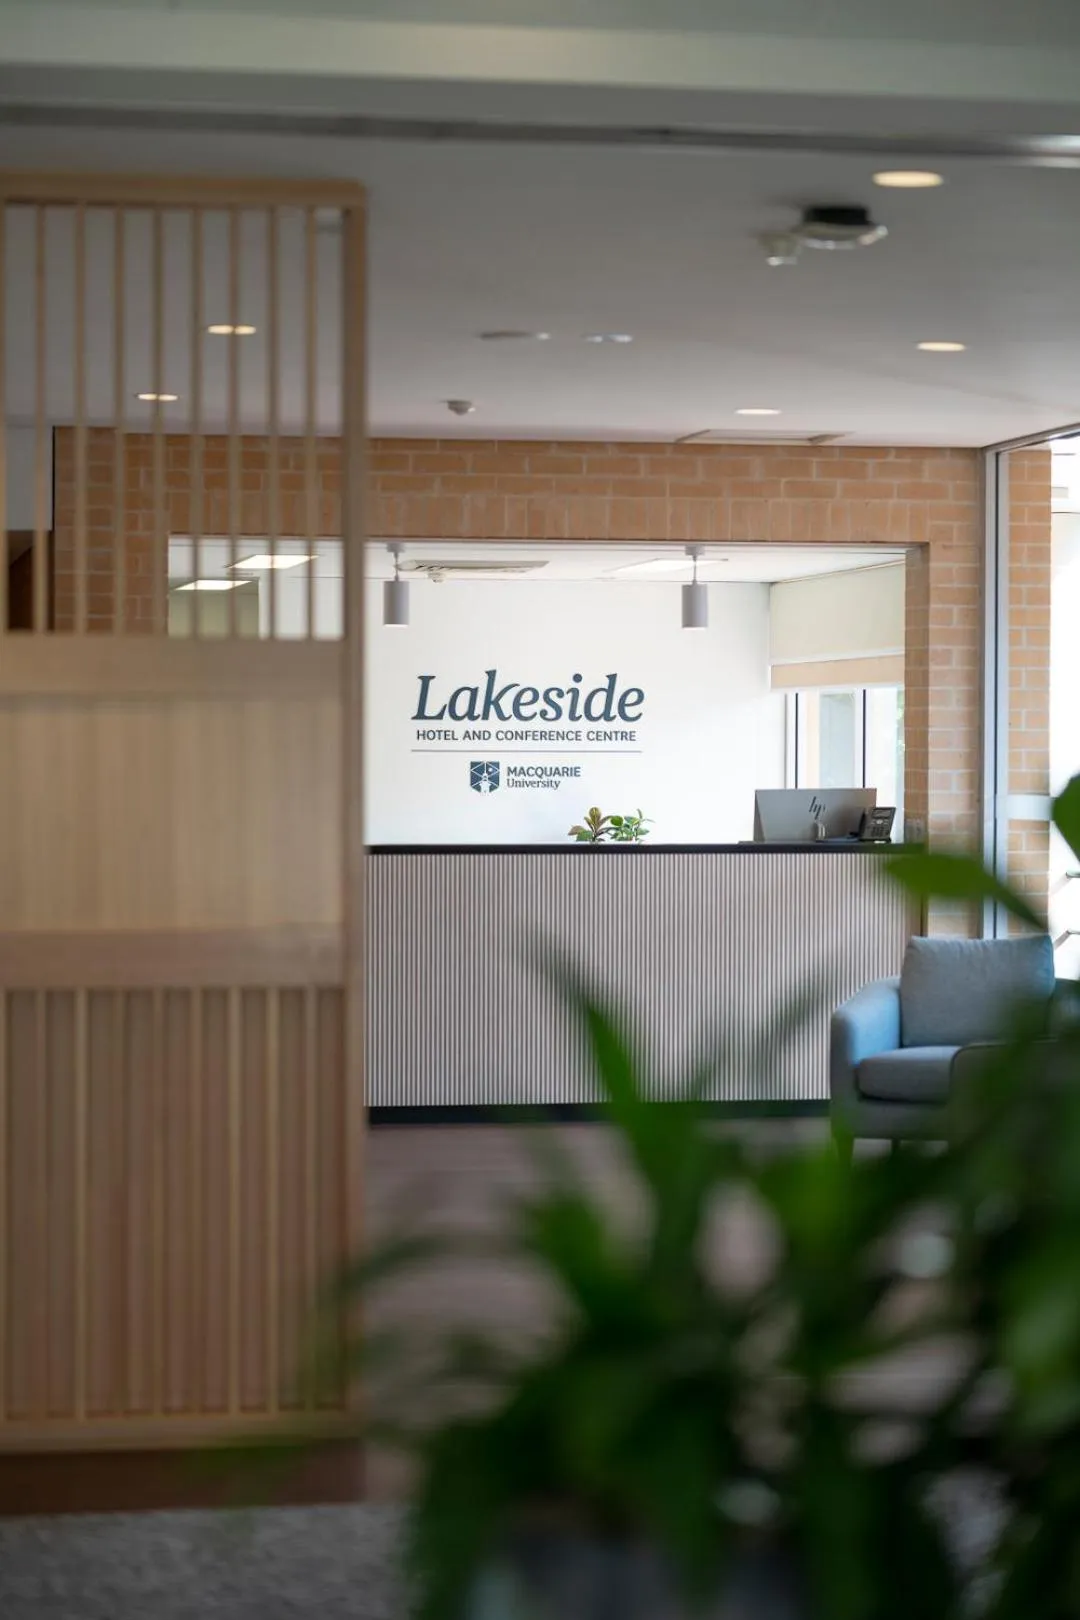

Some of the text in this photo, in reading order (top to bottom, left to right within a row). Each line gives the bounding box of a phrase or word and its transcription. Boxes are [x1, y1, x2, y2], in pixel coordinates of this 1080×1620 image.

[411, 669, 645, 722] Lakeside
[416, 729, 637, 742] HOTEL AND CONFERENCE CENTRE
[506, 766, 581, 778] MACQUARIE
[506, 778, 561, 790] University
